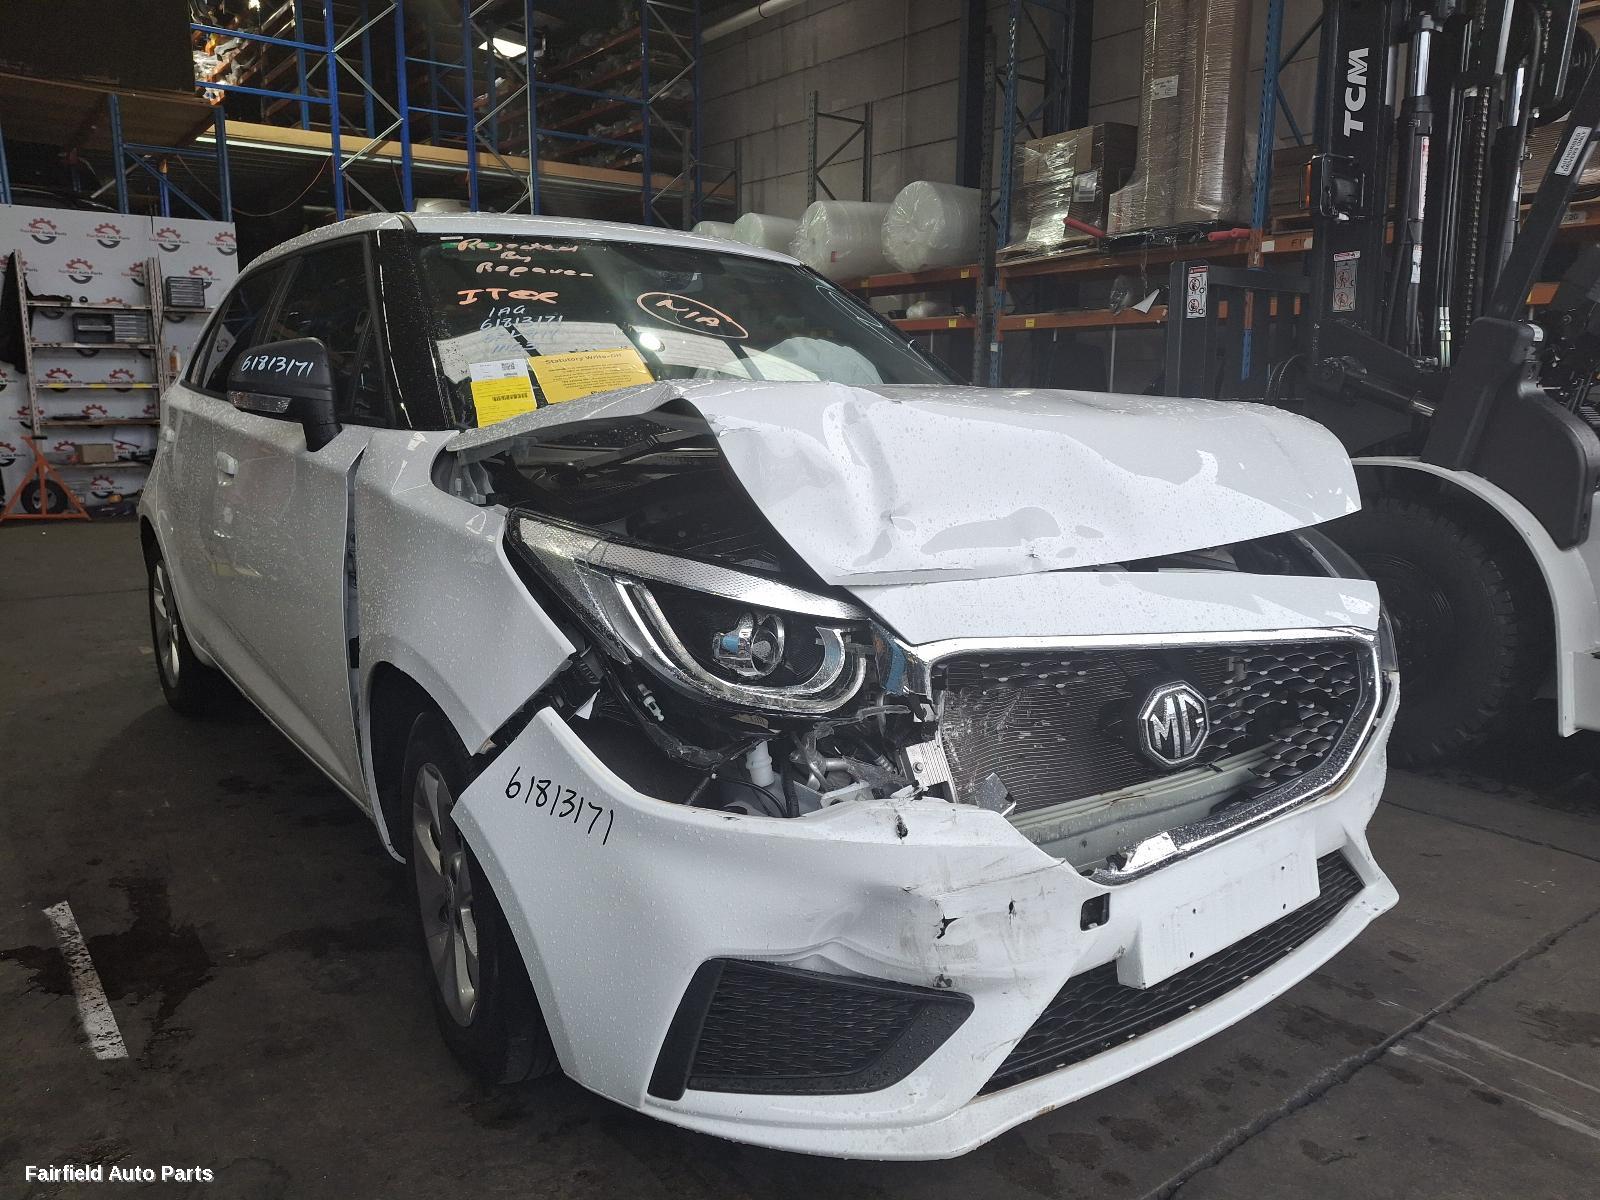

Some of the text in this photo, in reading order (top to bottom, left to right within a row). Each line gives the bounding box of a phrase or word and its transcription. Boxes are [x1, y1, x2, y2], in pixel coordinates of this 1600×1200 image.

[1343, 47, 1369, 137] TCM
[240, 355, 314, 377] 61813171
[544, 355, 585, 365] Statutory
[1149, 693, 1205, 759] MG
[505, 766, 614, 845] 61813171
